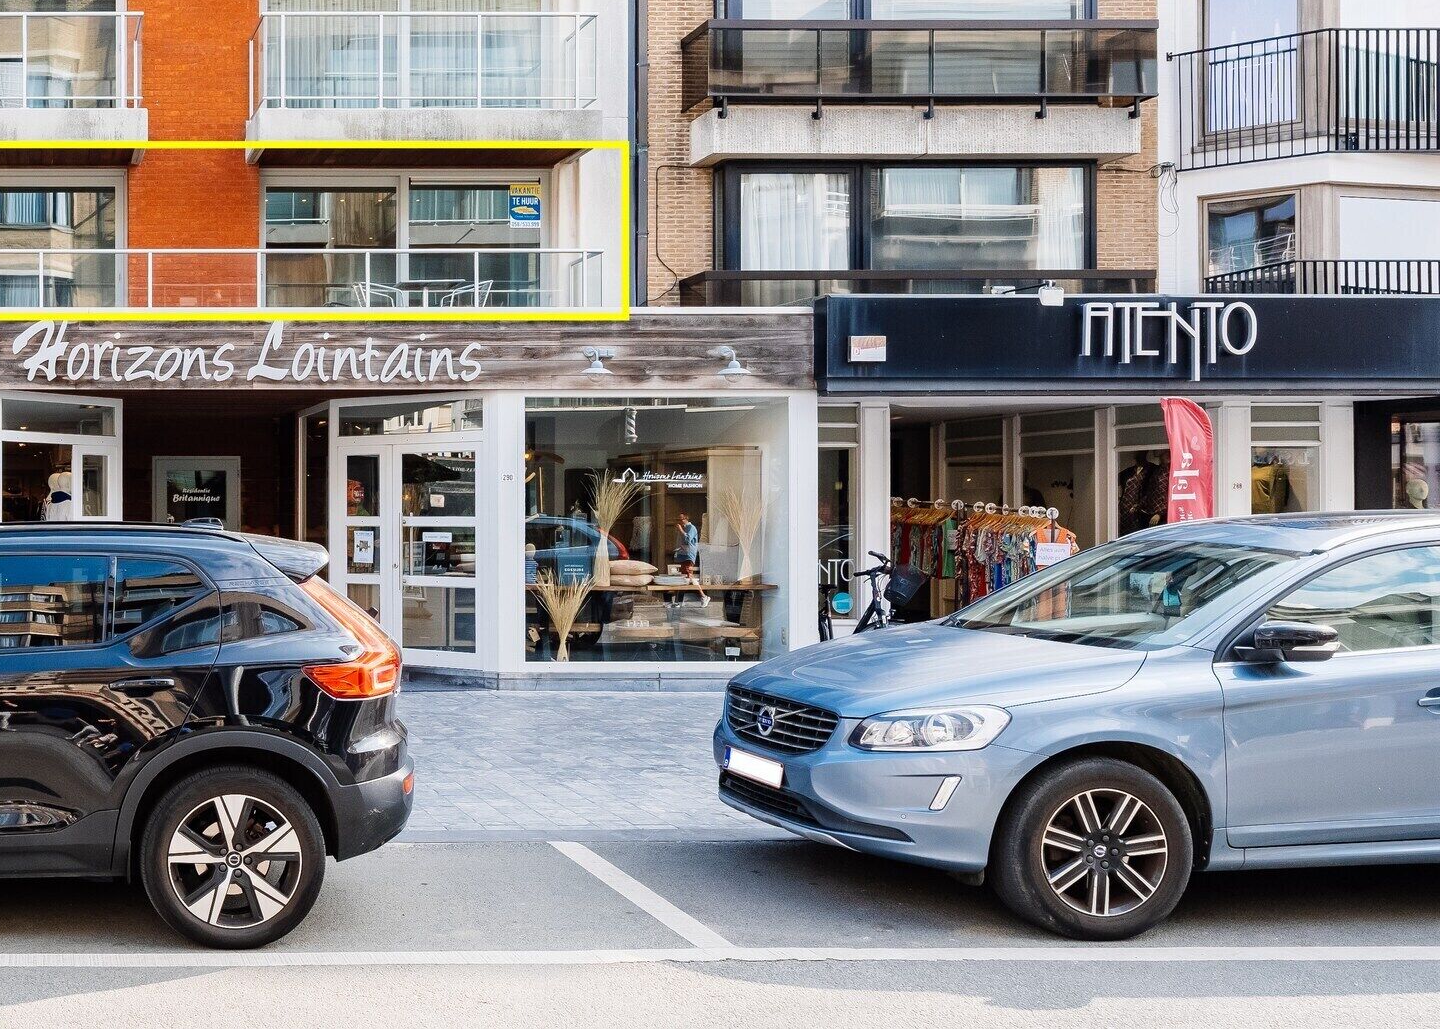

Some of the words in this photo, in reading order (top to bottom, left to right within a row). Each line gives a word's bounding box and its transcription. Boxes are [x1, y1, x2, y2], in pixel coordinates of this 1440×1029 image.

[511, 185, 540, 195] VAKANTIE
[512, 197, 520, 206] TE
[521, 197, 539, 206] HUUR
[12, 319, 235, 382] Horizons
[247, 318, 482, 383] Lointains
[172, 494, 220, 503] Britannique
